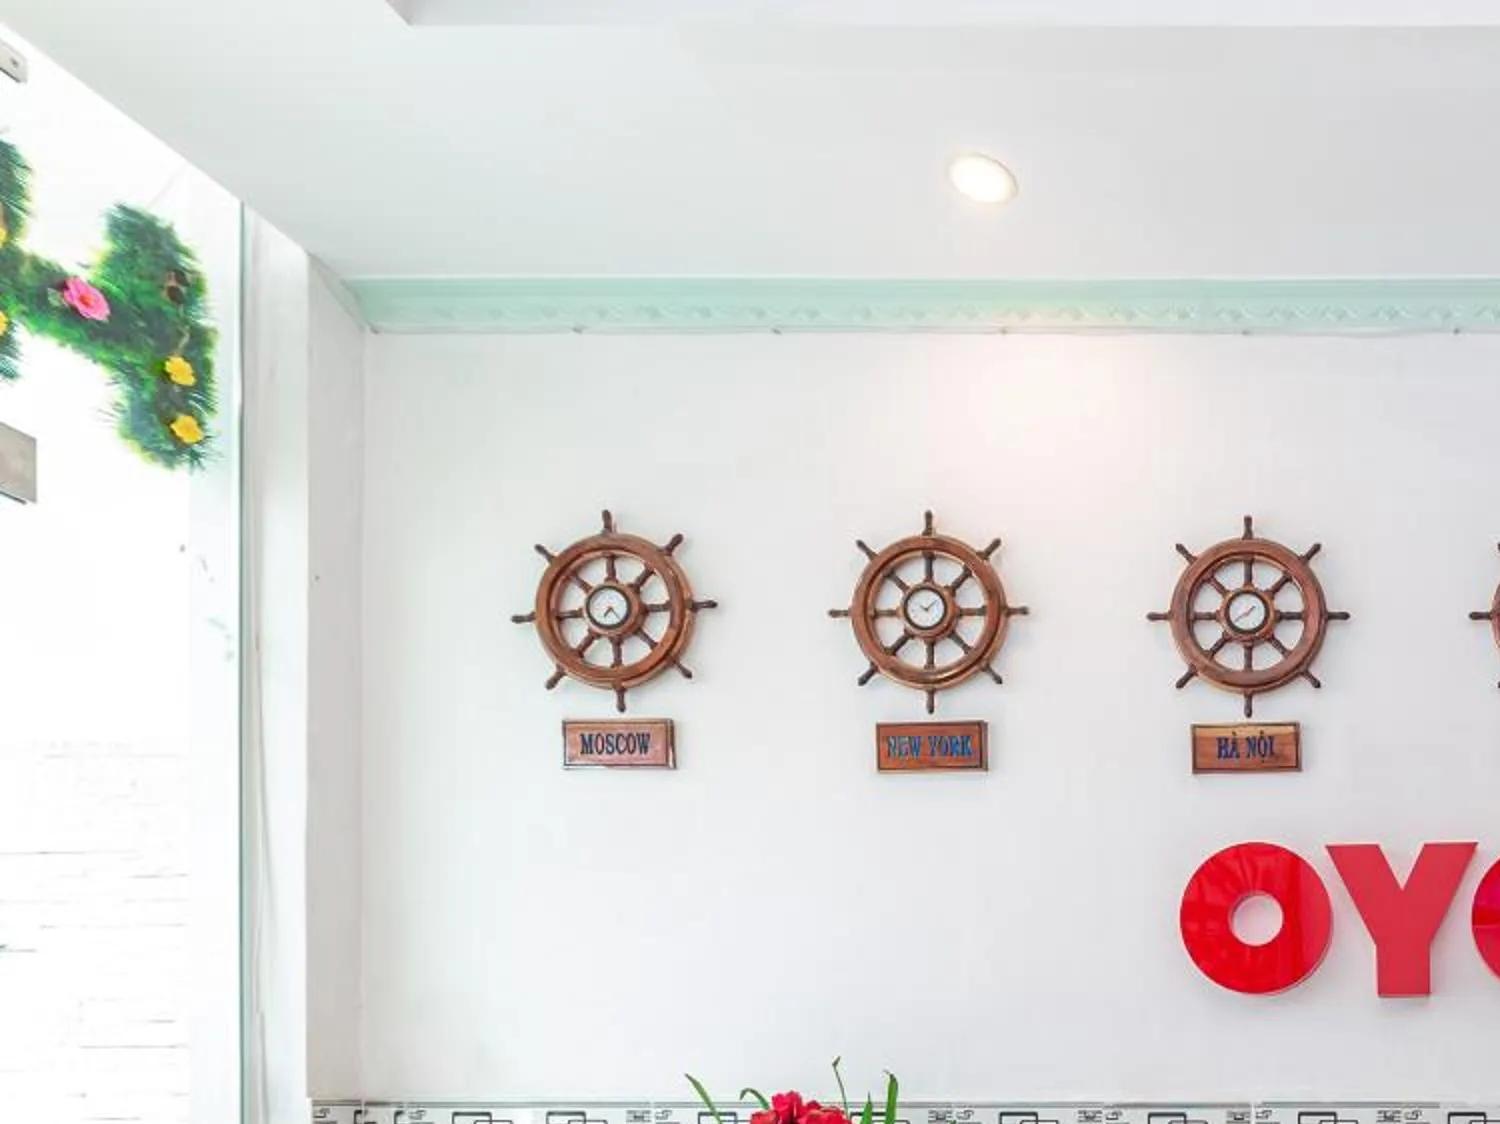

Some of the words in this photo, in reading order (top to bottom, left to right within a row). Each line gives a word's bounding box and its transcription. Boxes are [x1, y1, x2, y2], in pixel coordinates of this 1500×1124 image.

[579, 732, 650, 755] MOSCOW
[885, 734, 922, 758] NEW
[927, 734, 973, 757] YORK
[1216, 730, 1240, 759] HÀ
[1245, 729, 1275, 763] NỘI
